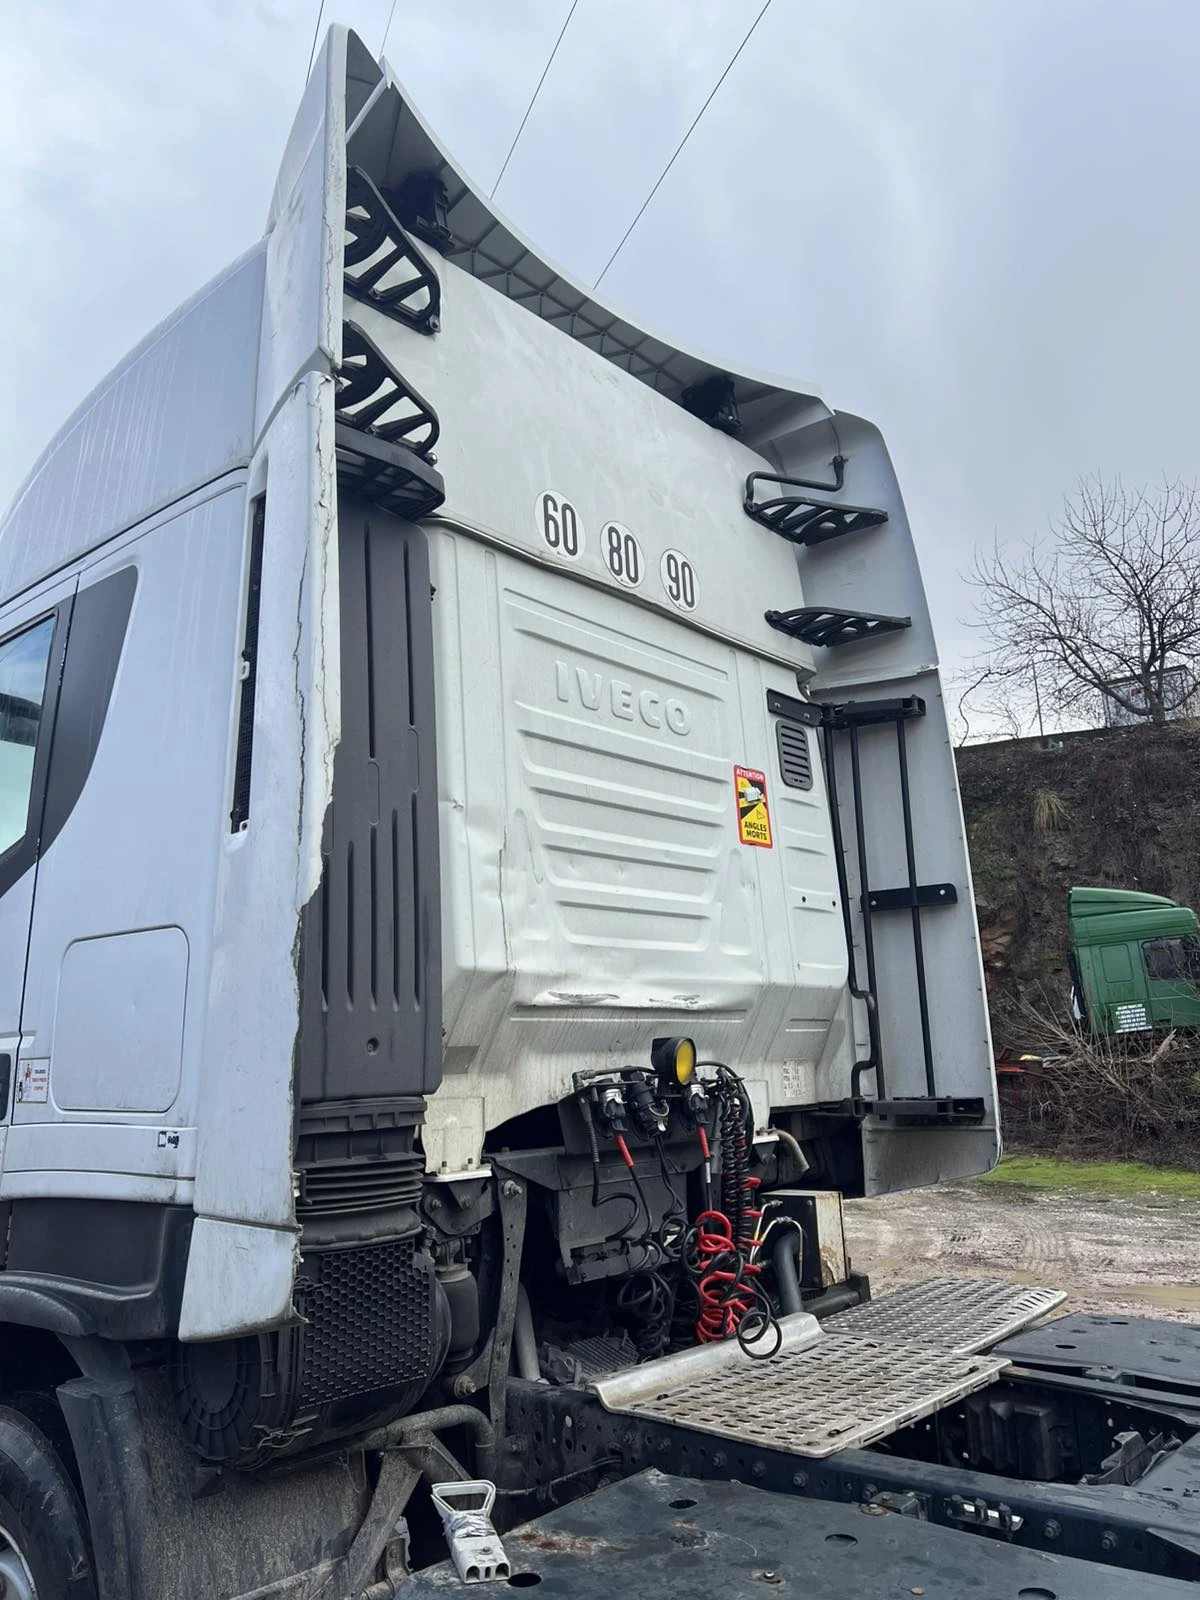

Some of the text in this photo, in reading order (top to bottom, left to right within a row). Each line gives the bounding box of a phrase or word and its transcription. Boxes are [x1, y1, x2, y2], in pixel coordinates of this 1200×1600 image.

[543, 494, 578, 556] 60
[607, 526, 639, 584] 80
[666, 553, 695, 608] 90
[555, 660, 692, 737] IVECO
[736, 768, 764, 781] ATTENTION
[744, 821, 767, 832] ANGLES
[746, 829, 767, 841] MORTS
